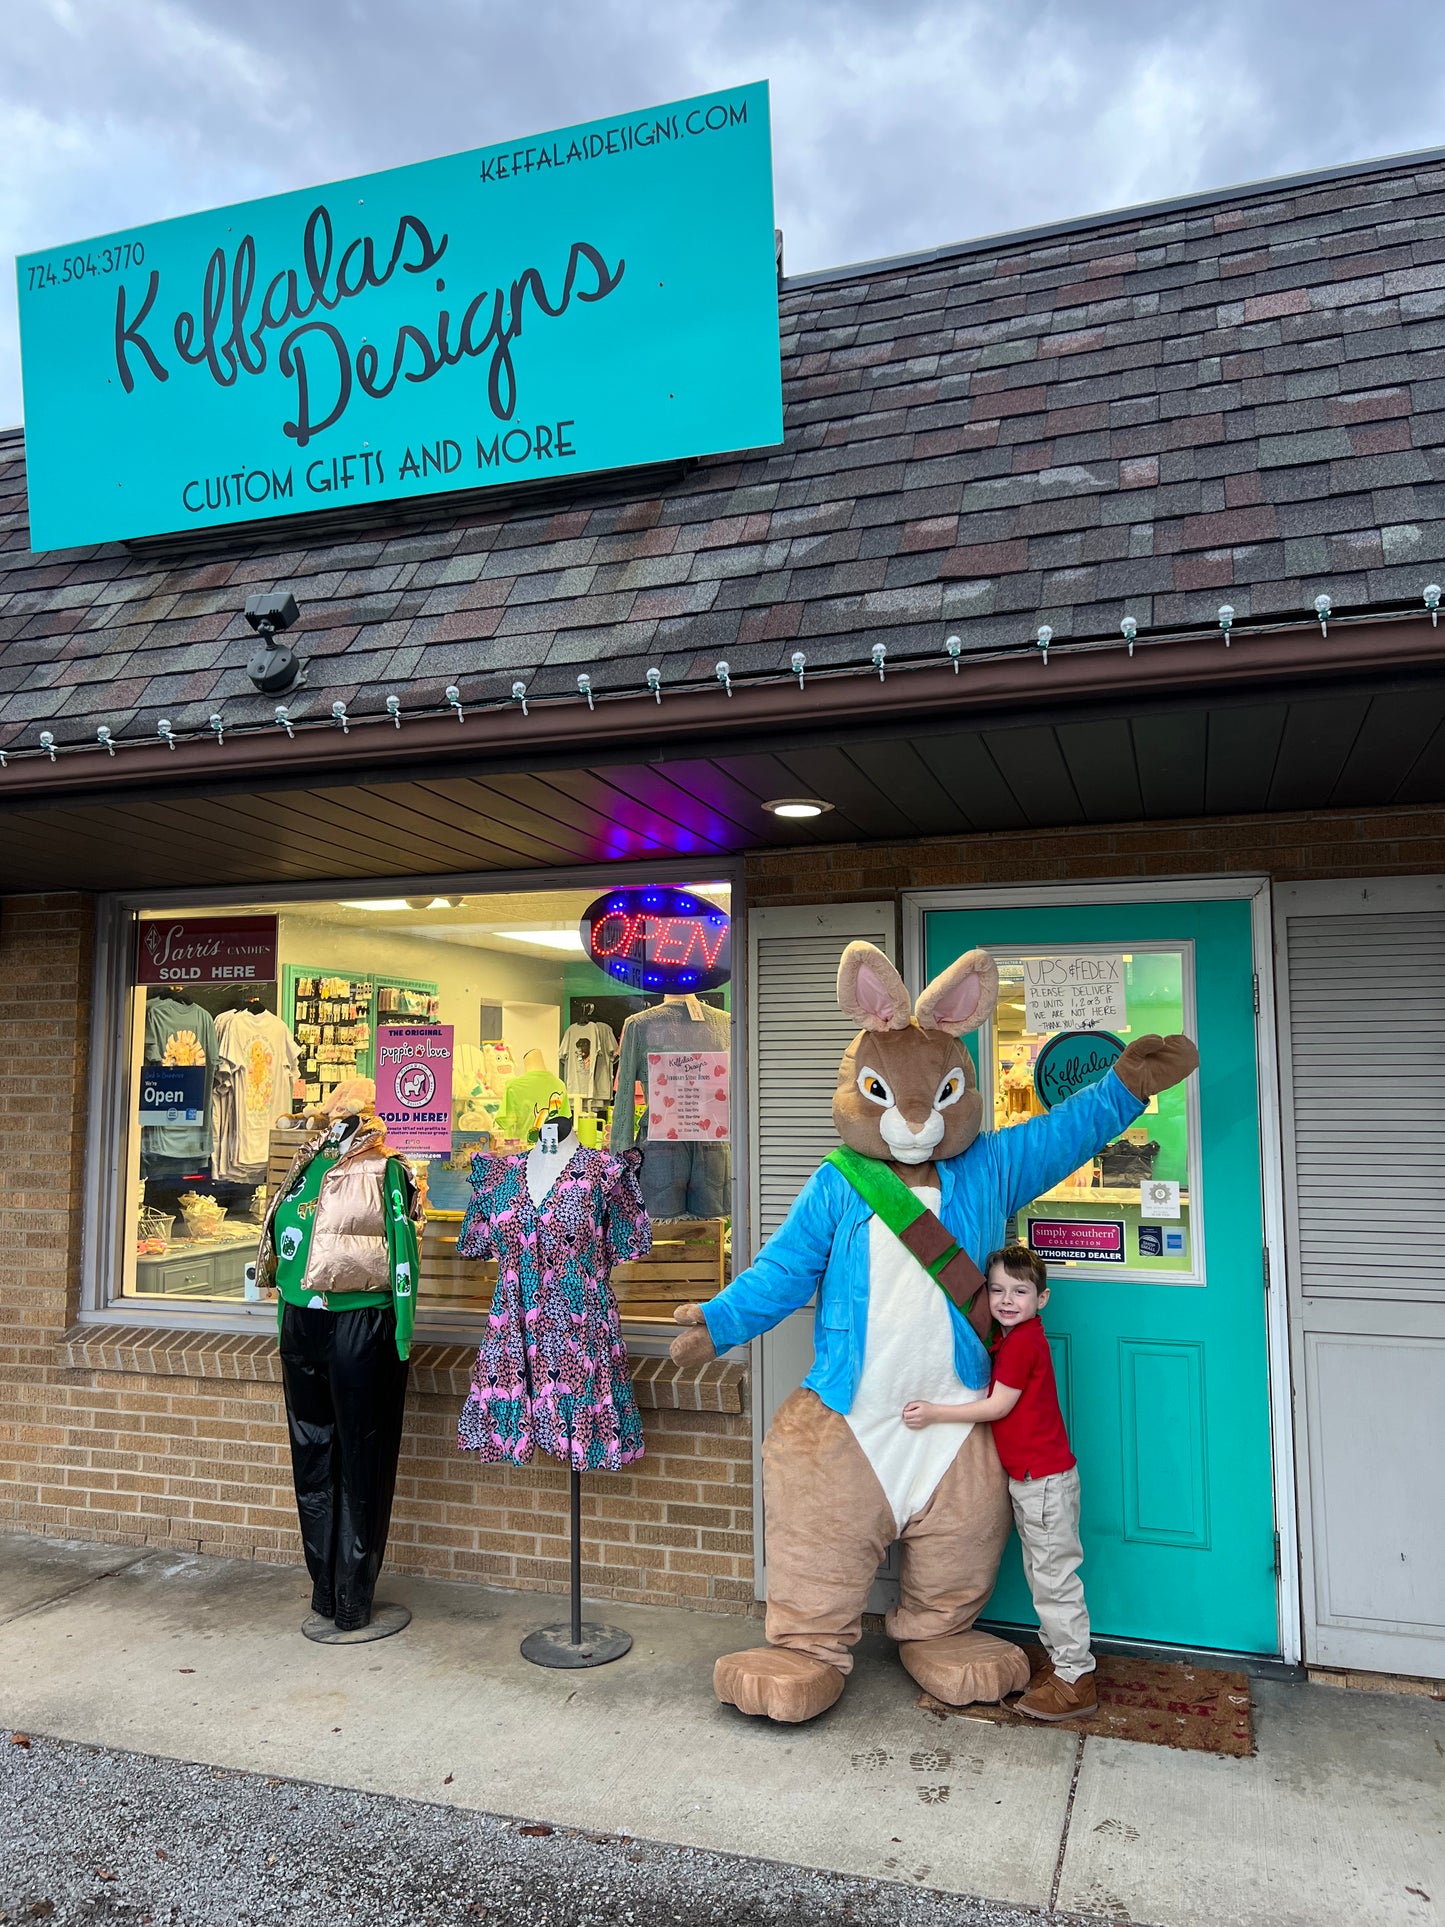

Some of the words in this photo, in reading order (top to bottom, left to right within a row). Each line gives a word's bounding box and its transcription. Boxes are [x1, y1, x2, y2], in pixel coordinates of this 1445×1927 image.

[480, 99, 748, 182] KEFFALASDESIGNS.COM
[27, 242, 145, 291] 724.504.3770
[115, 205, 449, 395] Keffalas
[279, 241, 626, 447] Designs
[182, 466, 293, 512] CUSTOM
[305, 450, 384, 493] GIFTS
[399, 439, 462, 480] AND
[475, 420, 577, 469] MORE
[153, 924, 221, 966] Sarris
[227, 945, 271, 956] CANDIES
[591, 911, 728, 970] OPEN
[159, 967, 202, 980] SOLD
[211, 965, 256, 979] HERE
[1026, 959, 1068, 985] UPS
[1075, 957, 1119, 981] FEDEX
[1030, 987, 1066, 998] PLEASE
[1072, 984, 1114, 997] DELIVER
[1043, 999, 1064, 1008] UNITS
[1105, 996, 1113, 1004] IF
[1034, 1011, 1045, 1019] WE
[1052, 1010, 1065, 1018] ARE
[1071, 1009, 1086, 1017] NOT
[1092, 1006, 1117, 1016] HERE
[380, 1042, 413, 1066] puppie
[144, 1087, 184, 1106] Open
[379, 1112, 410, 1122] SOLD
[413, 1112, 448, 1122] HERE!
[1036, 1226, 1067, 1238] simply
[1088, 1252, 1122, 1260] DEALER
